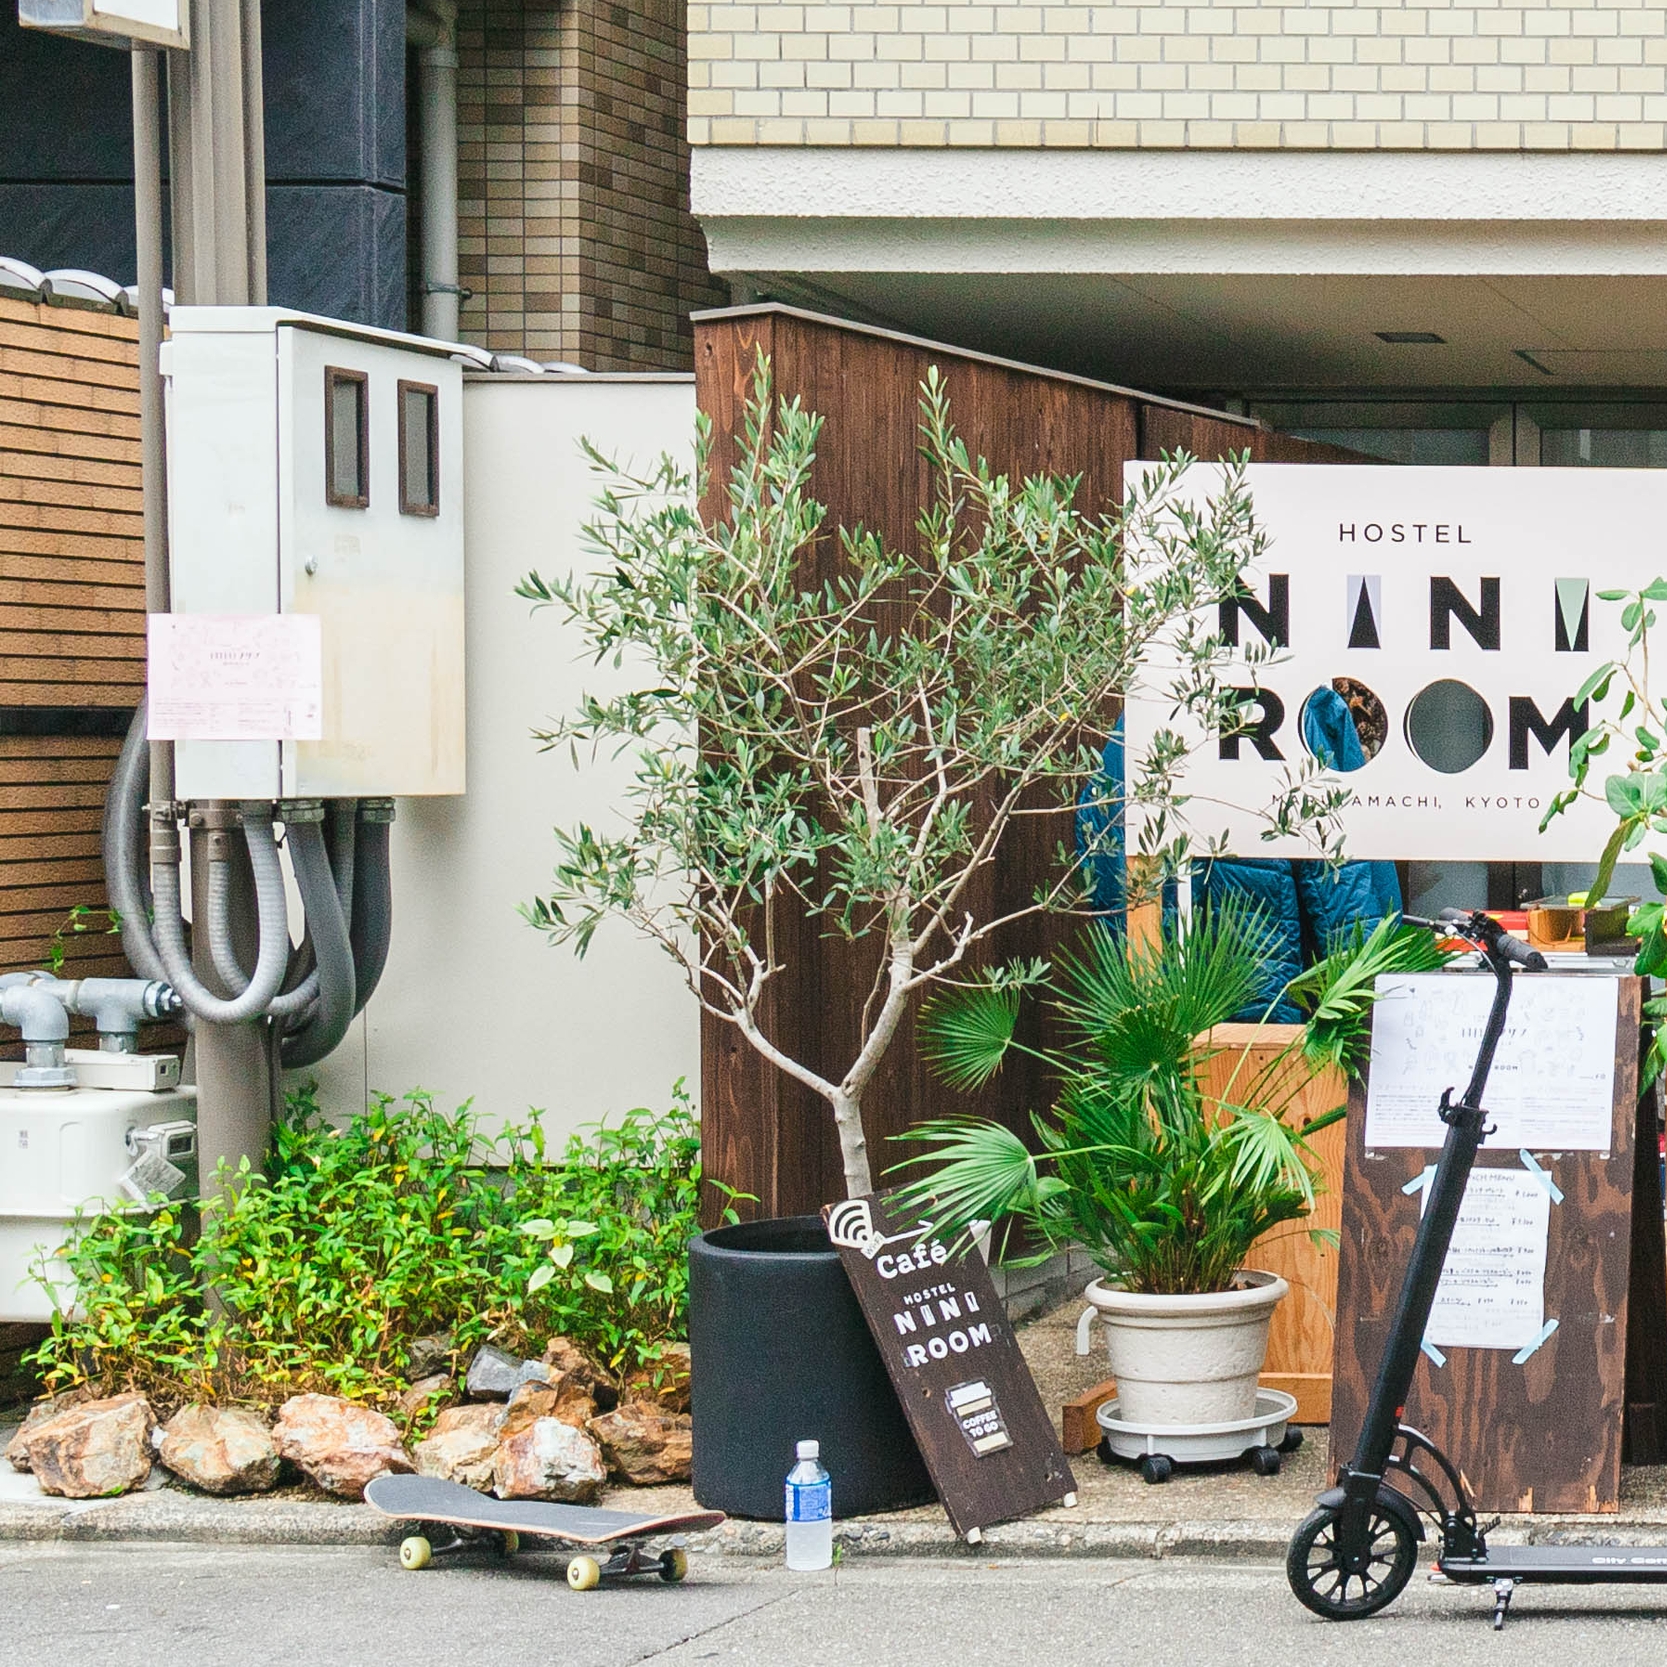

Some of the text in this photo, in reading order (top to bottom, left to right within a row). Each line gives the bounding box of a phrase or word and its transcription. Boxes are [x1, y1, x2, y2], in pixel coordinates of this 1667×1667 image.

[1338, 522, 1473, 544] HOSTEL
[1218, 573, 1590, 653] NINI
[1218, 676, 1590, 774] ROOM
[1465, 796, 1541, 810] KYOTO
[876, 1238, 948, 1280] Café
[903, 1282, 956, 1305] HOSTEL
[893, 1291, 980, 1336] NINI
[906, 1322, 992, 1368] ROOM
[962, 1410, 998, 1429] COFFEE
[968, 1426, 984, 1438] TO
